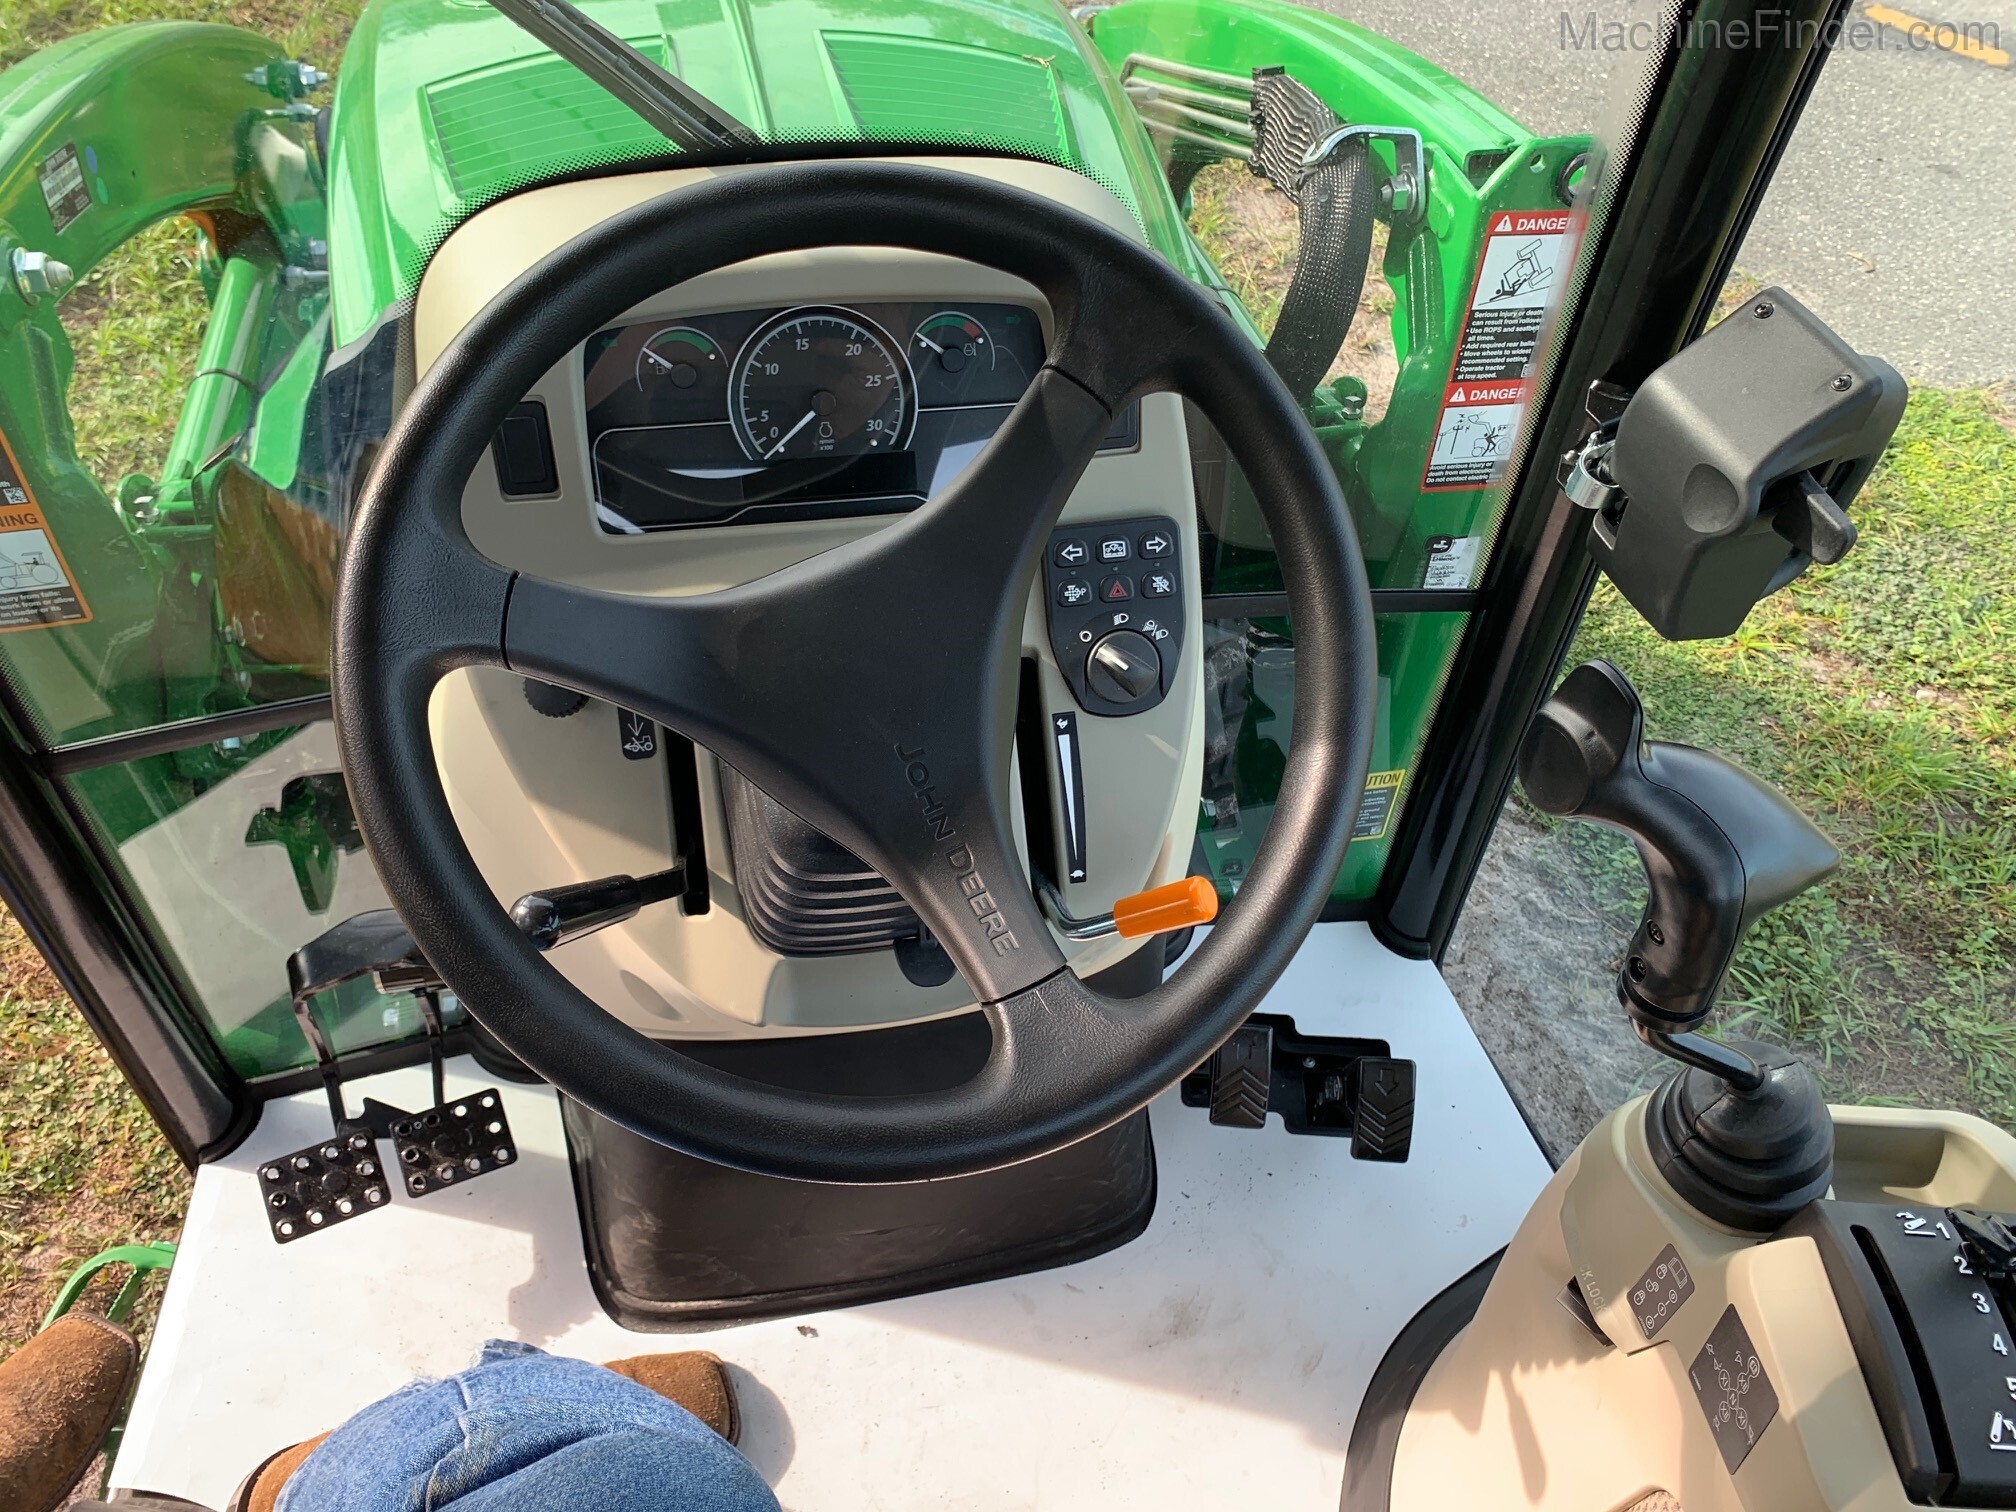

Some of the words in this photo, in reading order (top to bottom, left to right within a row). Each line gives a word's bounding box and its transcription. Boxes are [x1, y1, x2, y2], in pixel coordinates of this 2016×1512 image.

[1499, 310, 1517, 318] injury
[795, 338, 810, 350] 15
[844, 344, 862, 356] 20
[764, 363, 779, 375] 10
[864, 375, 882, 387] 25
[760, 410, 769, 422] 5
[866, 419, 883, 432] 30
[770, 426, 778, 438] 0
[1367, 772, 1401, 786] UTION
[894, 743, 956, 842] JOHN
[945, 843, 1019, 958] DEERE
[1936, 1222, 1950, 1240] 1
[1953, 1255, 1973, 1275] 2
[1972, 1292, 1990, 1314] 3
[1992, 1333, 2008, 1356] 4
